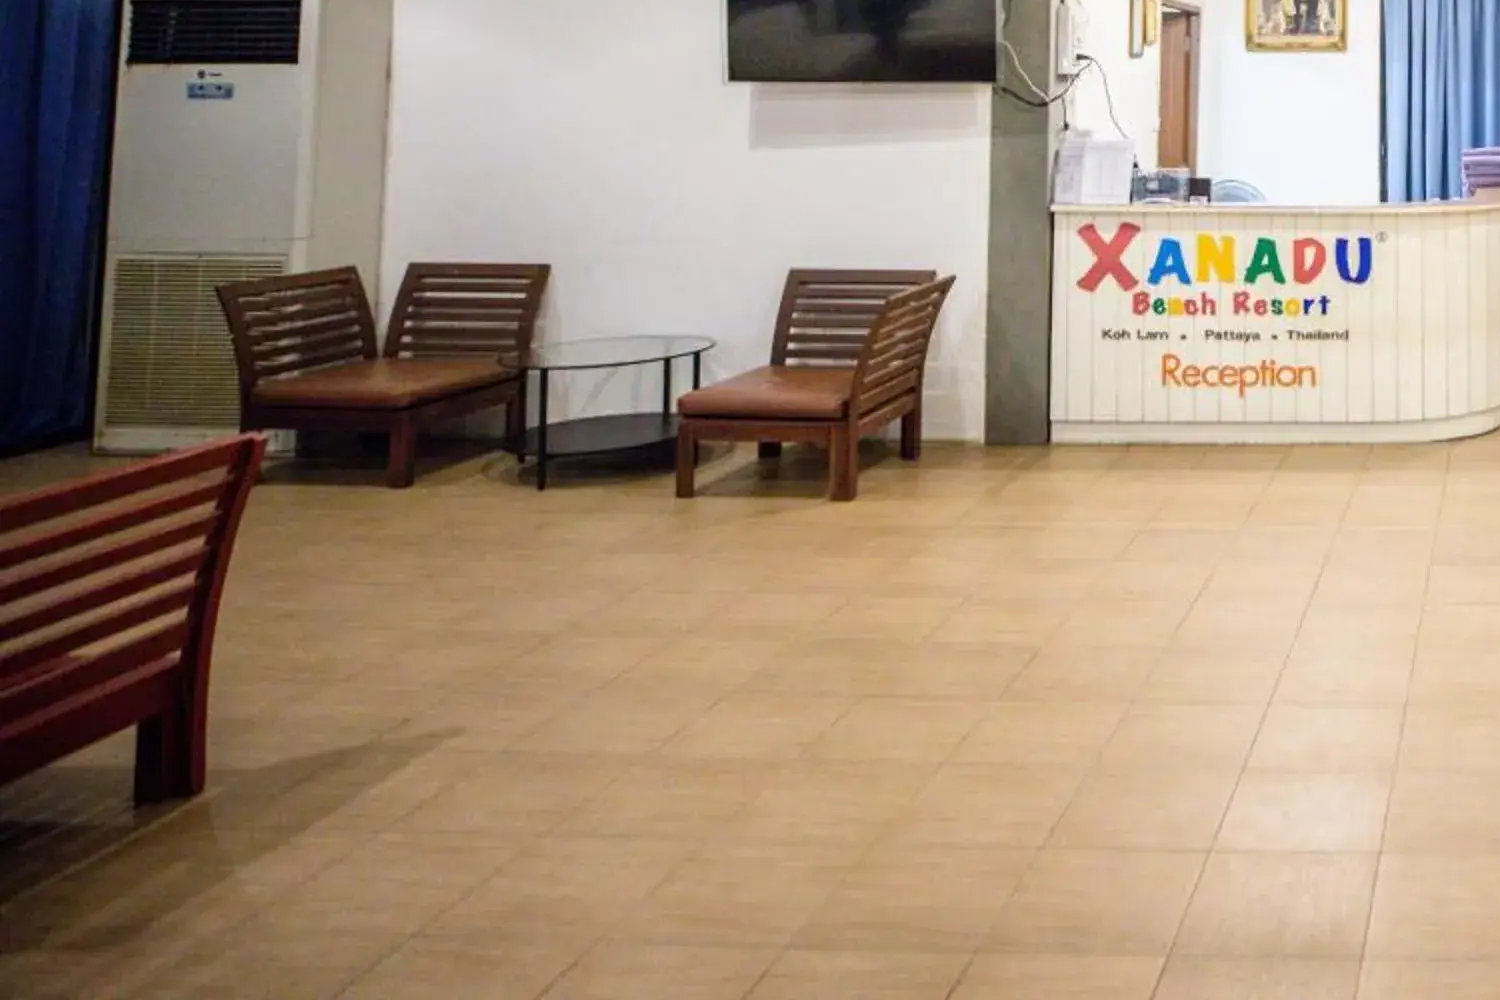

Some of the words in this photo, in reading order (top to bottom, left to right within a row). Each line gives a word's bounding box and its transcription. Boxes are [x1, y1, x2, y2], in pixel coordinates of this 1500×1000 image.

[1077, 222, 1373, 292] XANADU
[1132, 291, 1216, 316] Beach
[1233, 291, 1330, 316] Resort
[1101, 328, 1131, 341] Koh
[1204, 329, 1261, 343] Pattaya
[1287, 328, 1349, 341] Thailand
[1161, 353, 1316, 397] Reception
